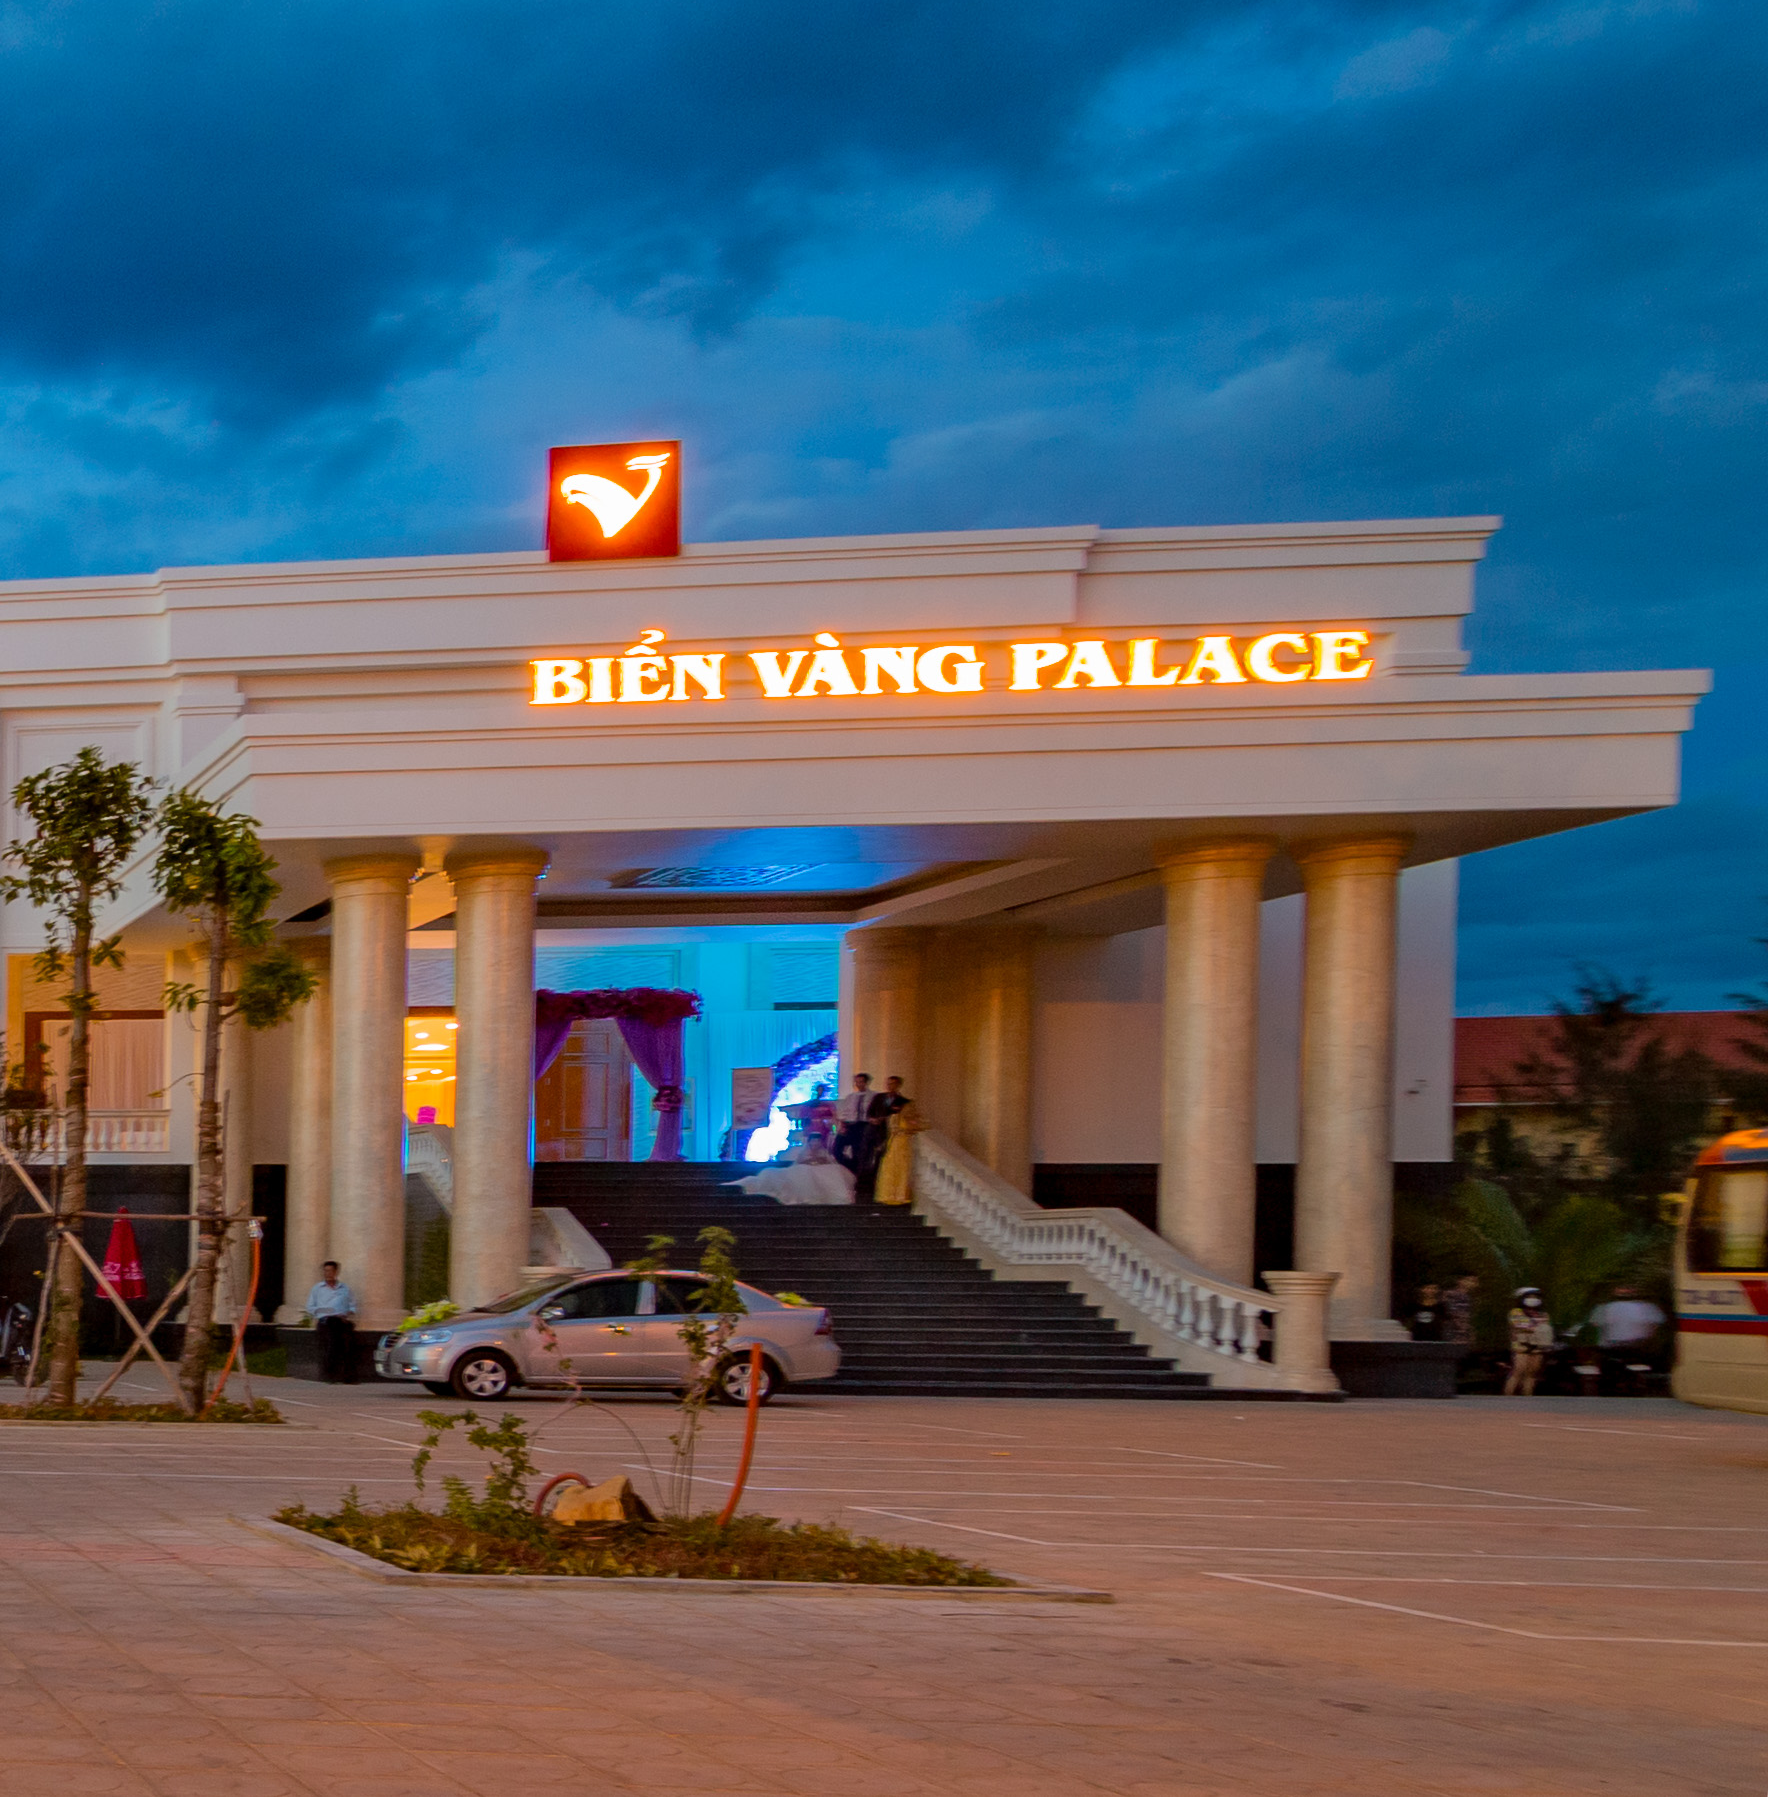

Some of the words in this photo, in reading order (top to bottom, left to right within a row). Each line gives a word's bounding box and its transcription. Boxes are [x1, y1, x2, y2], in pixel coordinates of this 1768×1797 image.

[528, 628, 726, 706] BIỂN
[746, 632, 987, 699] VÀNG
[1008, 631, 1375, 692] PALACE
